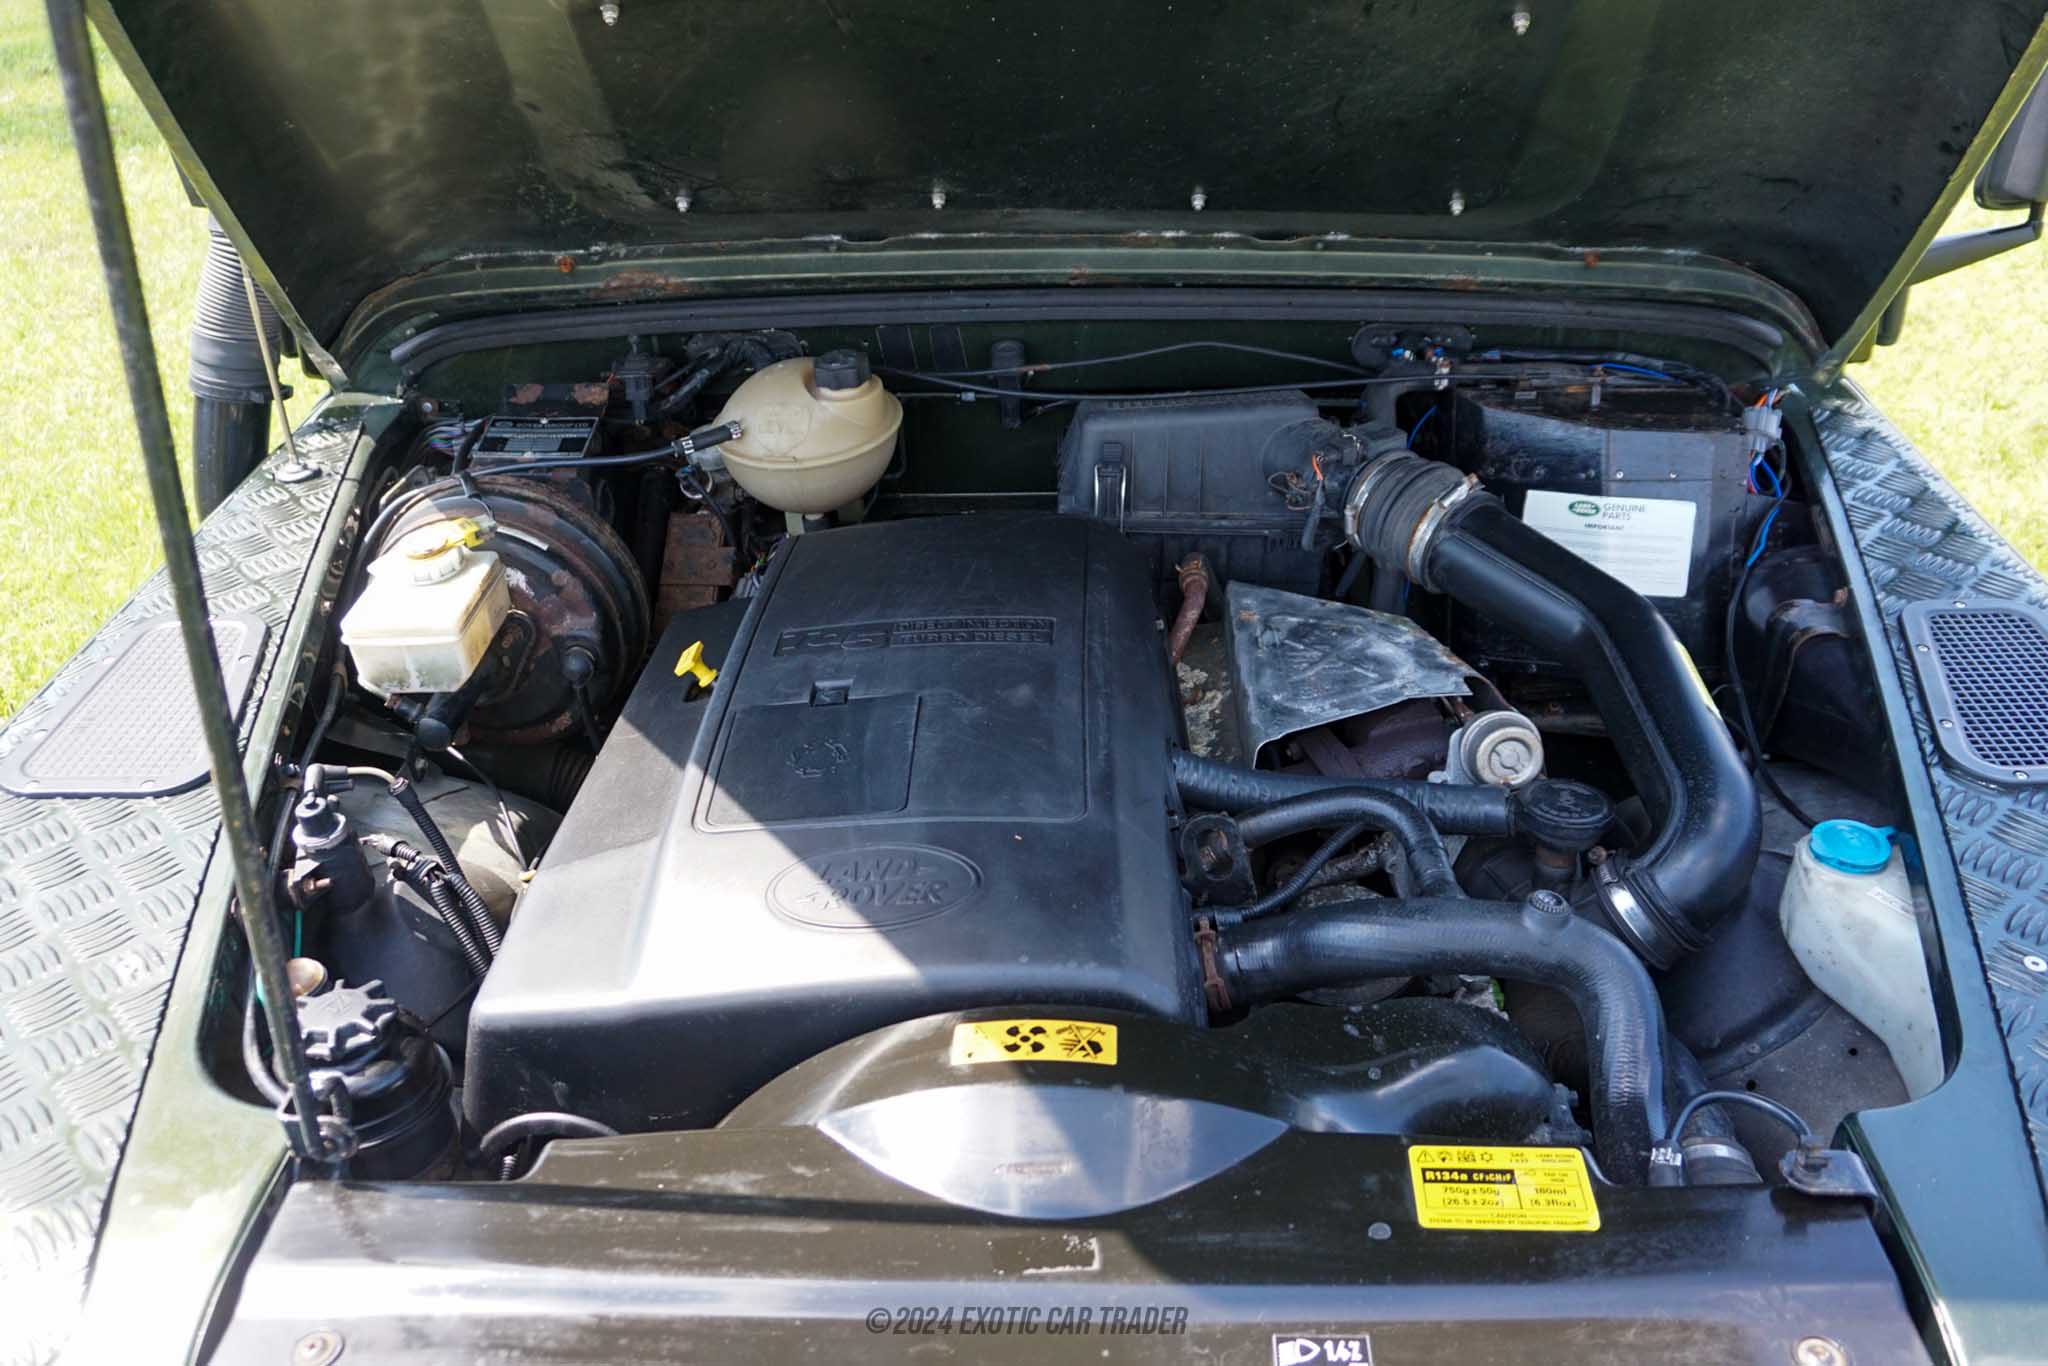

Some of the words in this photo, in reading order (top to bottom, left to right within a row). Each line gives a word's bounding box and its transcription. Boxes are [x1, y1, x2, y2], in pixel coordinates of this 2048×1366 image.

[1603, 503, 1646, 512] GENUINE
[1602, 511, 1632, 521] PARTS
[899, 632, 968, 644] TURBO
[973, 631, 1043, 642] DIESEL
[796, 880, 950, 911] ROVER
[1425, 1170, 1468, 1181] R134a
